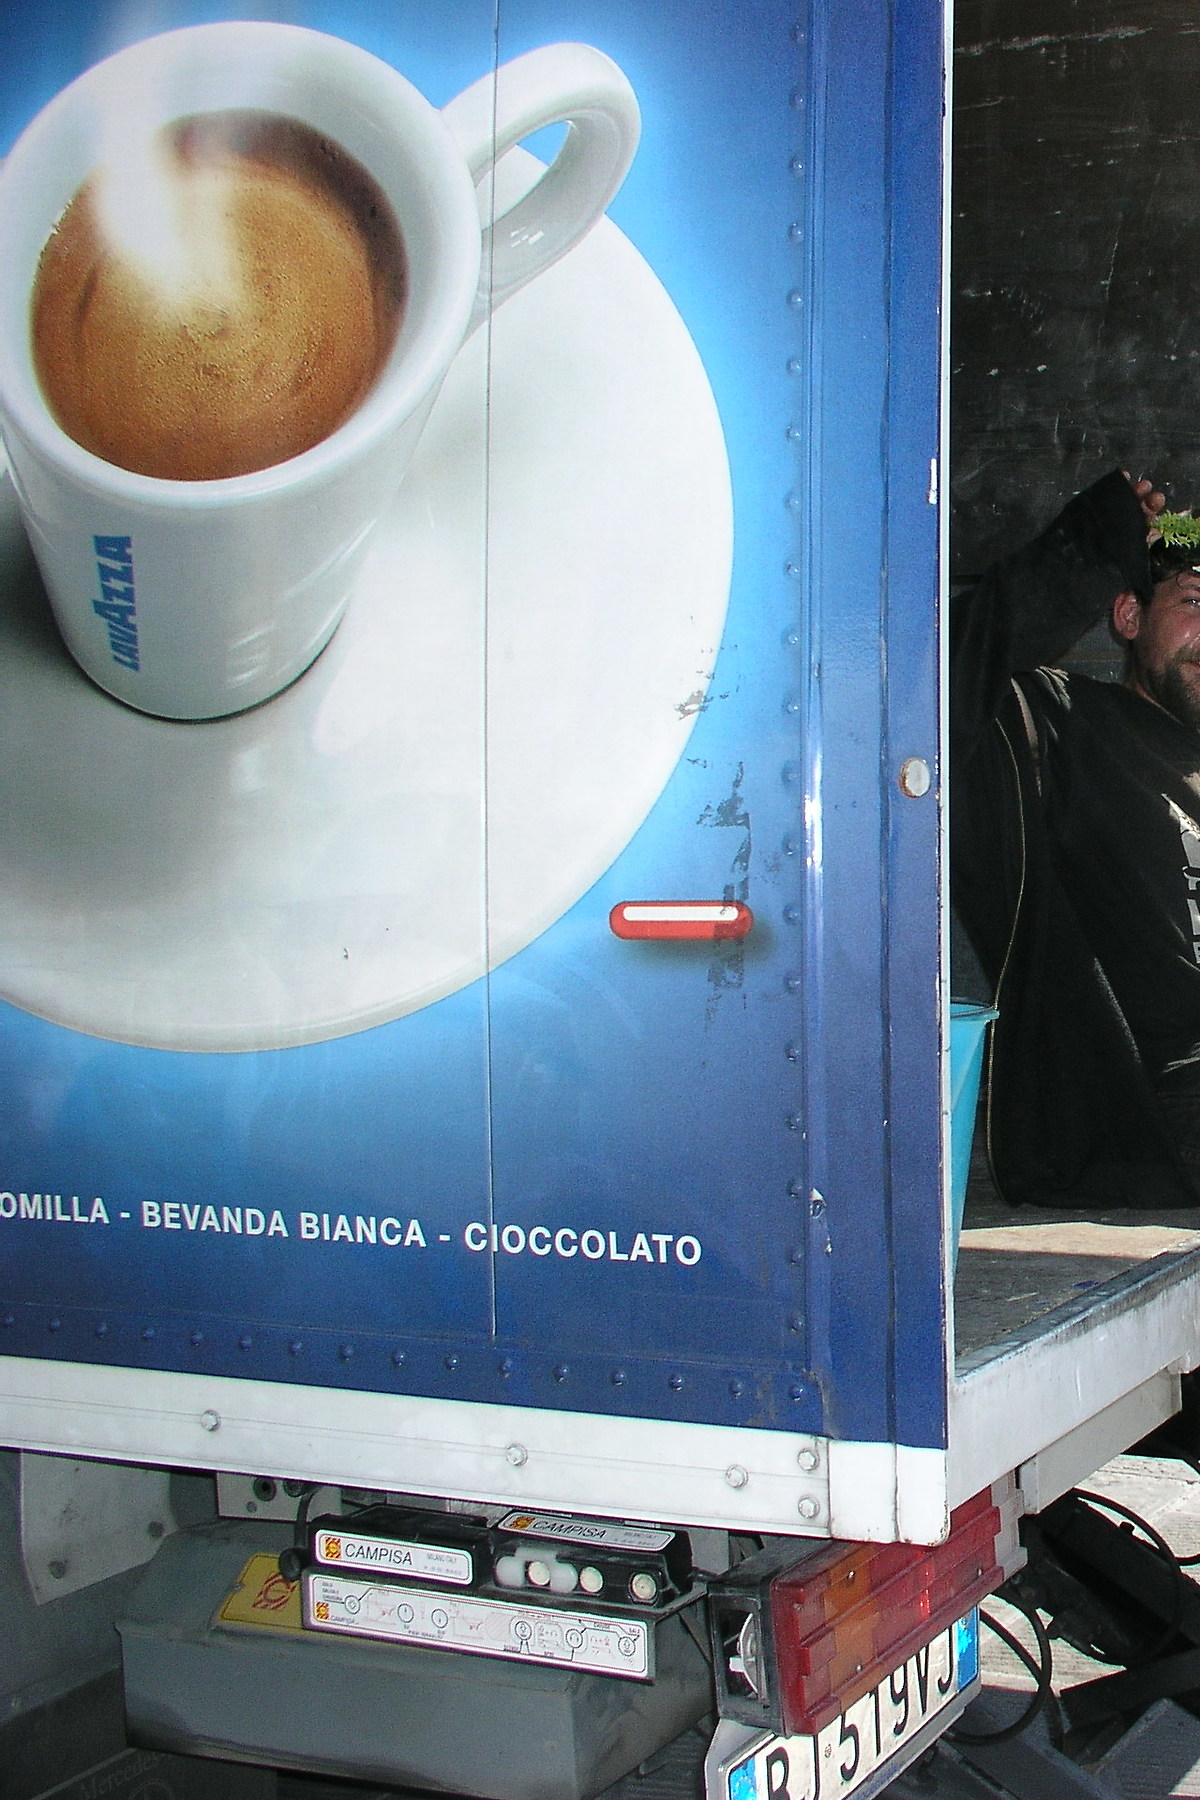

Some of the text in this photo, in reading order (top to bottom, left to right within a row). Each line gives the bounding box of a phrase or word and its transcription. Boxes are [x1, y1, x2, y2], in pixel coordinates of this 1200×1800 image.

[92, 535, 141, 672] LAVAZZA
[0, 1192, 110, 1224] OMILLA
[142, 1200, 289, 1237] BEVANDA
[300, 1212, 426, 1247] BIANCA
[465, 1222, 702, 1266] CIOCCOLATO
[533, 1520, 606, 1538] CAMPISA
[345, 1543, 412, 1565] CAMPISA
